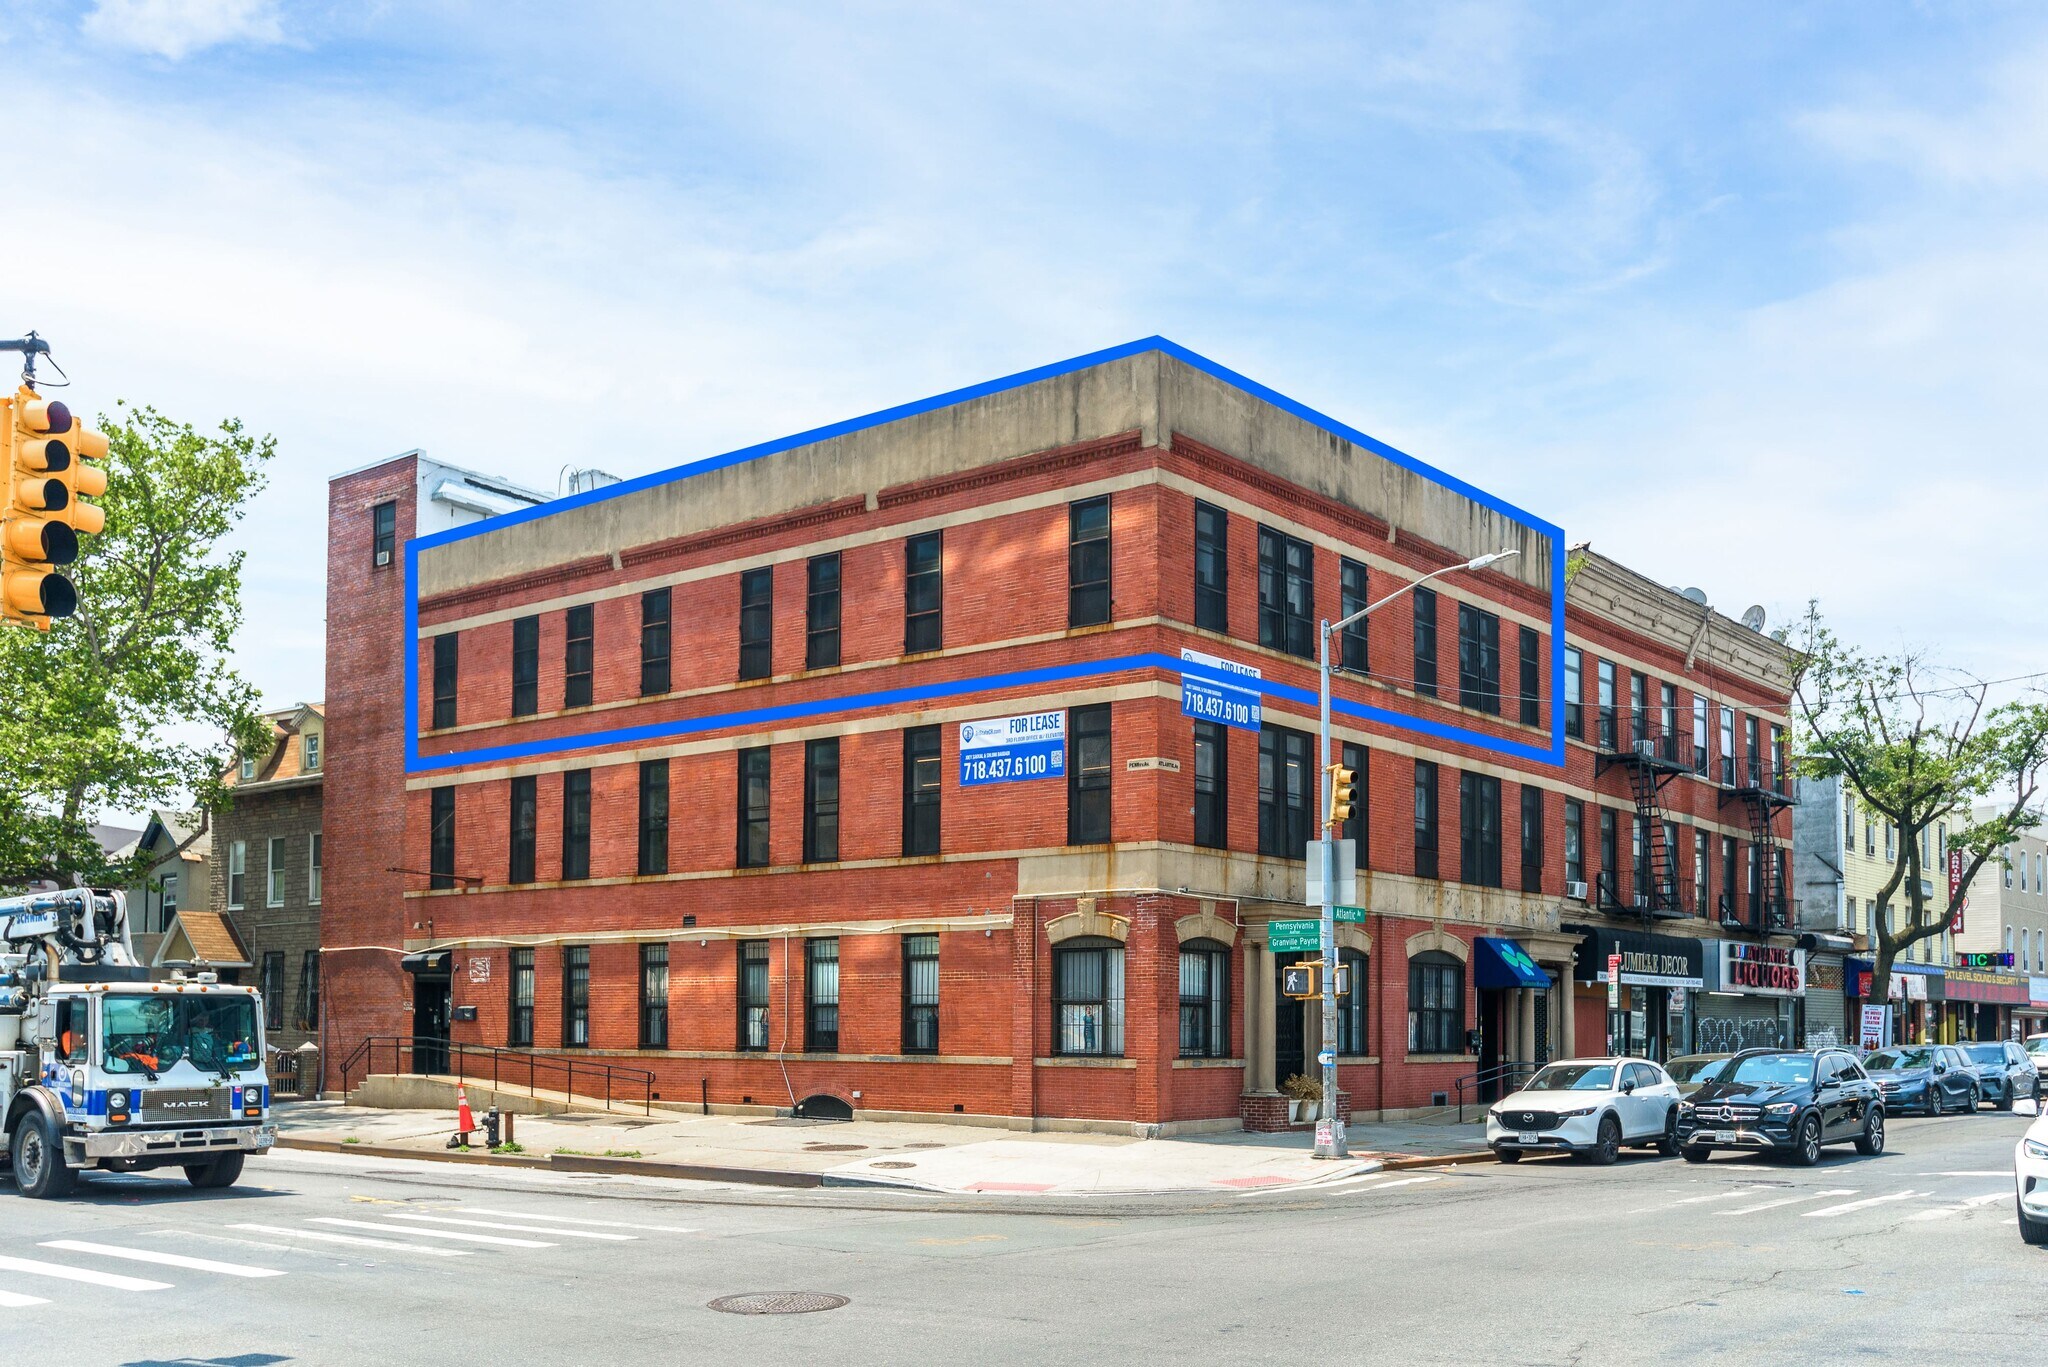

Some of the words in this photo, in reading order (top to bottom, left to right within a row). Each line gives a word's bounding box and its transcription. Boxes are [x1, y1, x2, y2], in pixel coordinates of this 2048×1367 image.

[1185, 691, 1248, 724] 718.437.6100
[1010, 718, 1028, 734] FOR
[1030, 714, 1060, 732] LEASE
[1046, 732, 1064, 740] ELEVATOR
[964, 754, 1046, 780] 718.437.6100
[16, 912, 48, 924] SCHWING
[1336, 908, 1356, 920] Atlantic
[1275, 922, 1314, 931] Pennsylvania
[1272, 938, 1298, 946] Granville
[1300, 937, 1318, 946] Payne
[1661, 954, 1688, 975] DECOR
[1735, 961, 1799, 989] LIQUORS
[1945, 970, 1955, 980] EXT
[1956, 971, 1972, 981] LEVEL
[1974, 973, 1992, 983] SOUND
[1996, 975, 2019, 986] SECURITY
